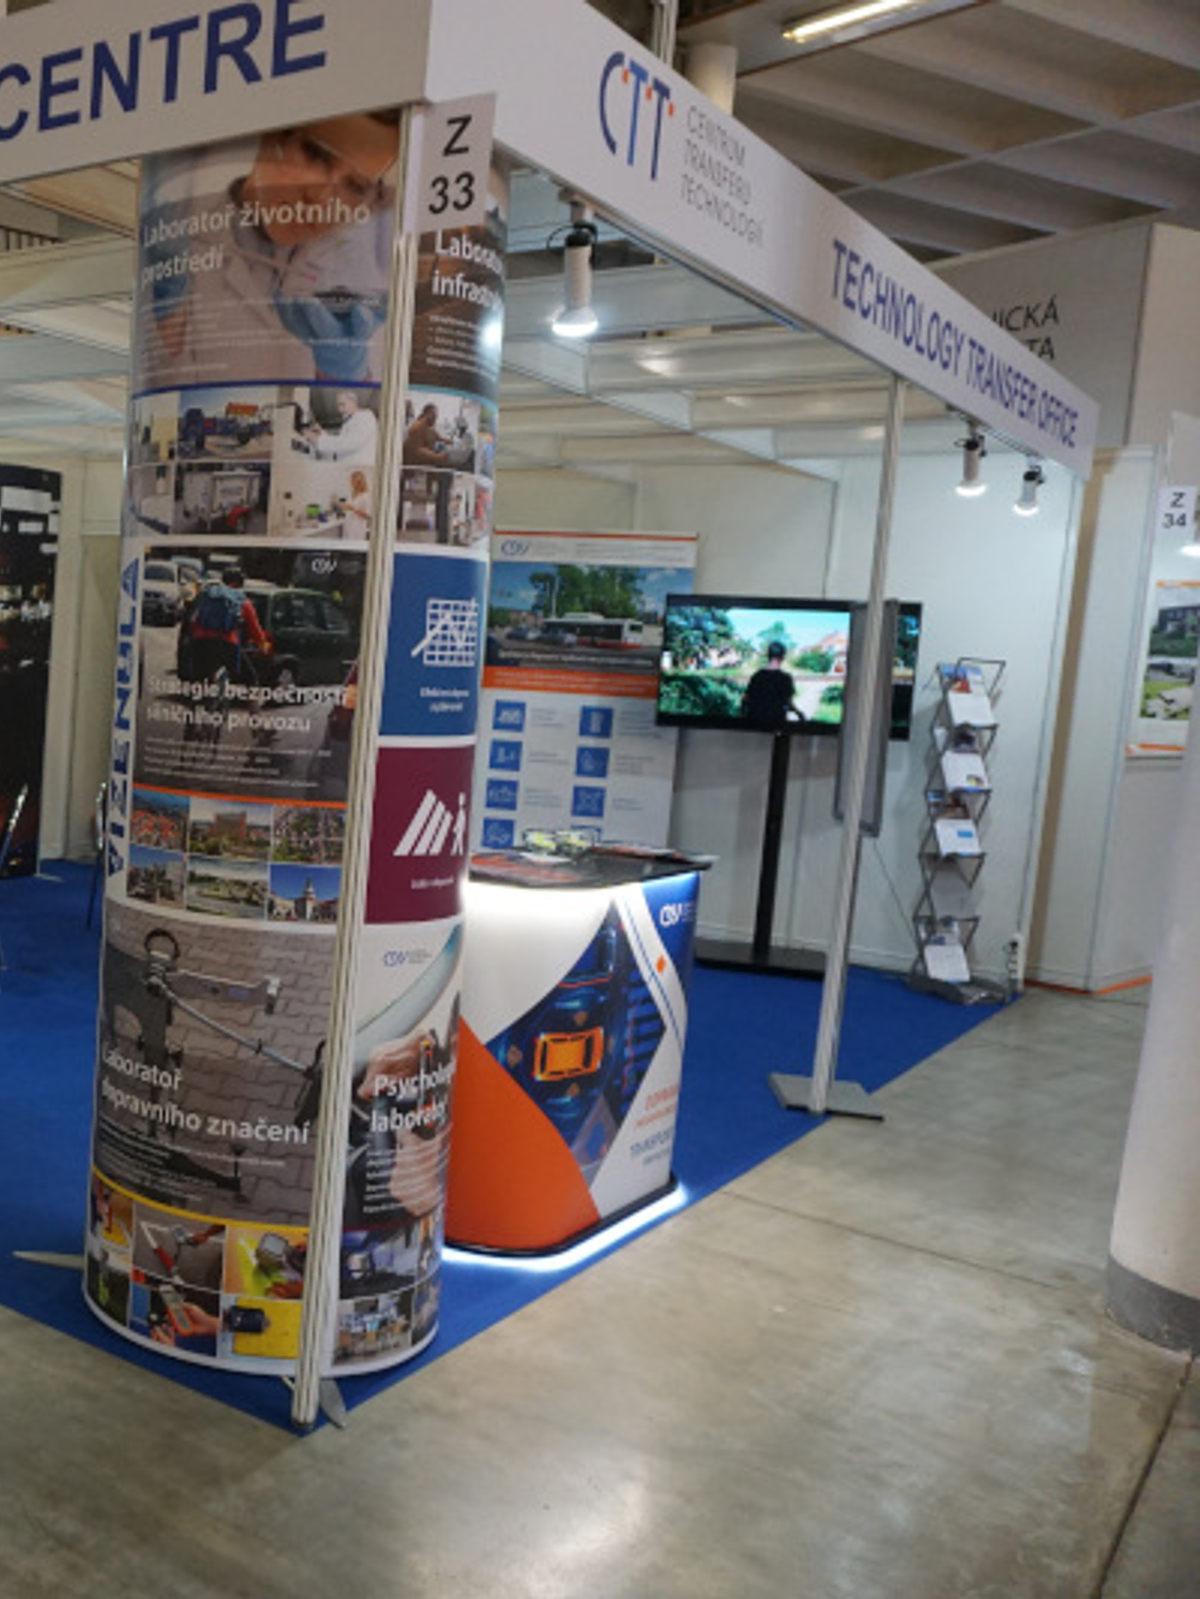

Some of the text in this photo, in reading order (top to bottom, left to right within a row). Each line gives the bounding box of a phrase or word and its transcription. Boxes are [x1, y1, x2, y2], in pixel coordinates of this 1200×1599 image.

[443, 115, 472, 157] Z
[599, 51, 673, 181] CTT
[687, 105, 745, 168] CENTRUM
[428, 171, 476, 214] 33
[684, 138, 751, 205] TRANSFERU
[143, 199, 370, 248] Laboratoř životního
[141, 245, 224, 290] prostředí
[833, 237, 1078, 448] TECHNOLOGY TRANSFER OFFICE
[1161, 512, 1186, 529] 34
[1171, 491, 1186, 508] Z
[227, 711, 311, 732] provozu
[207, 1116, 311, 1144] značení
